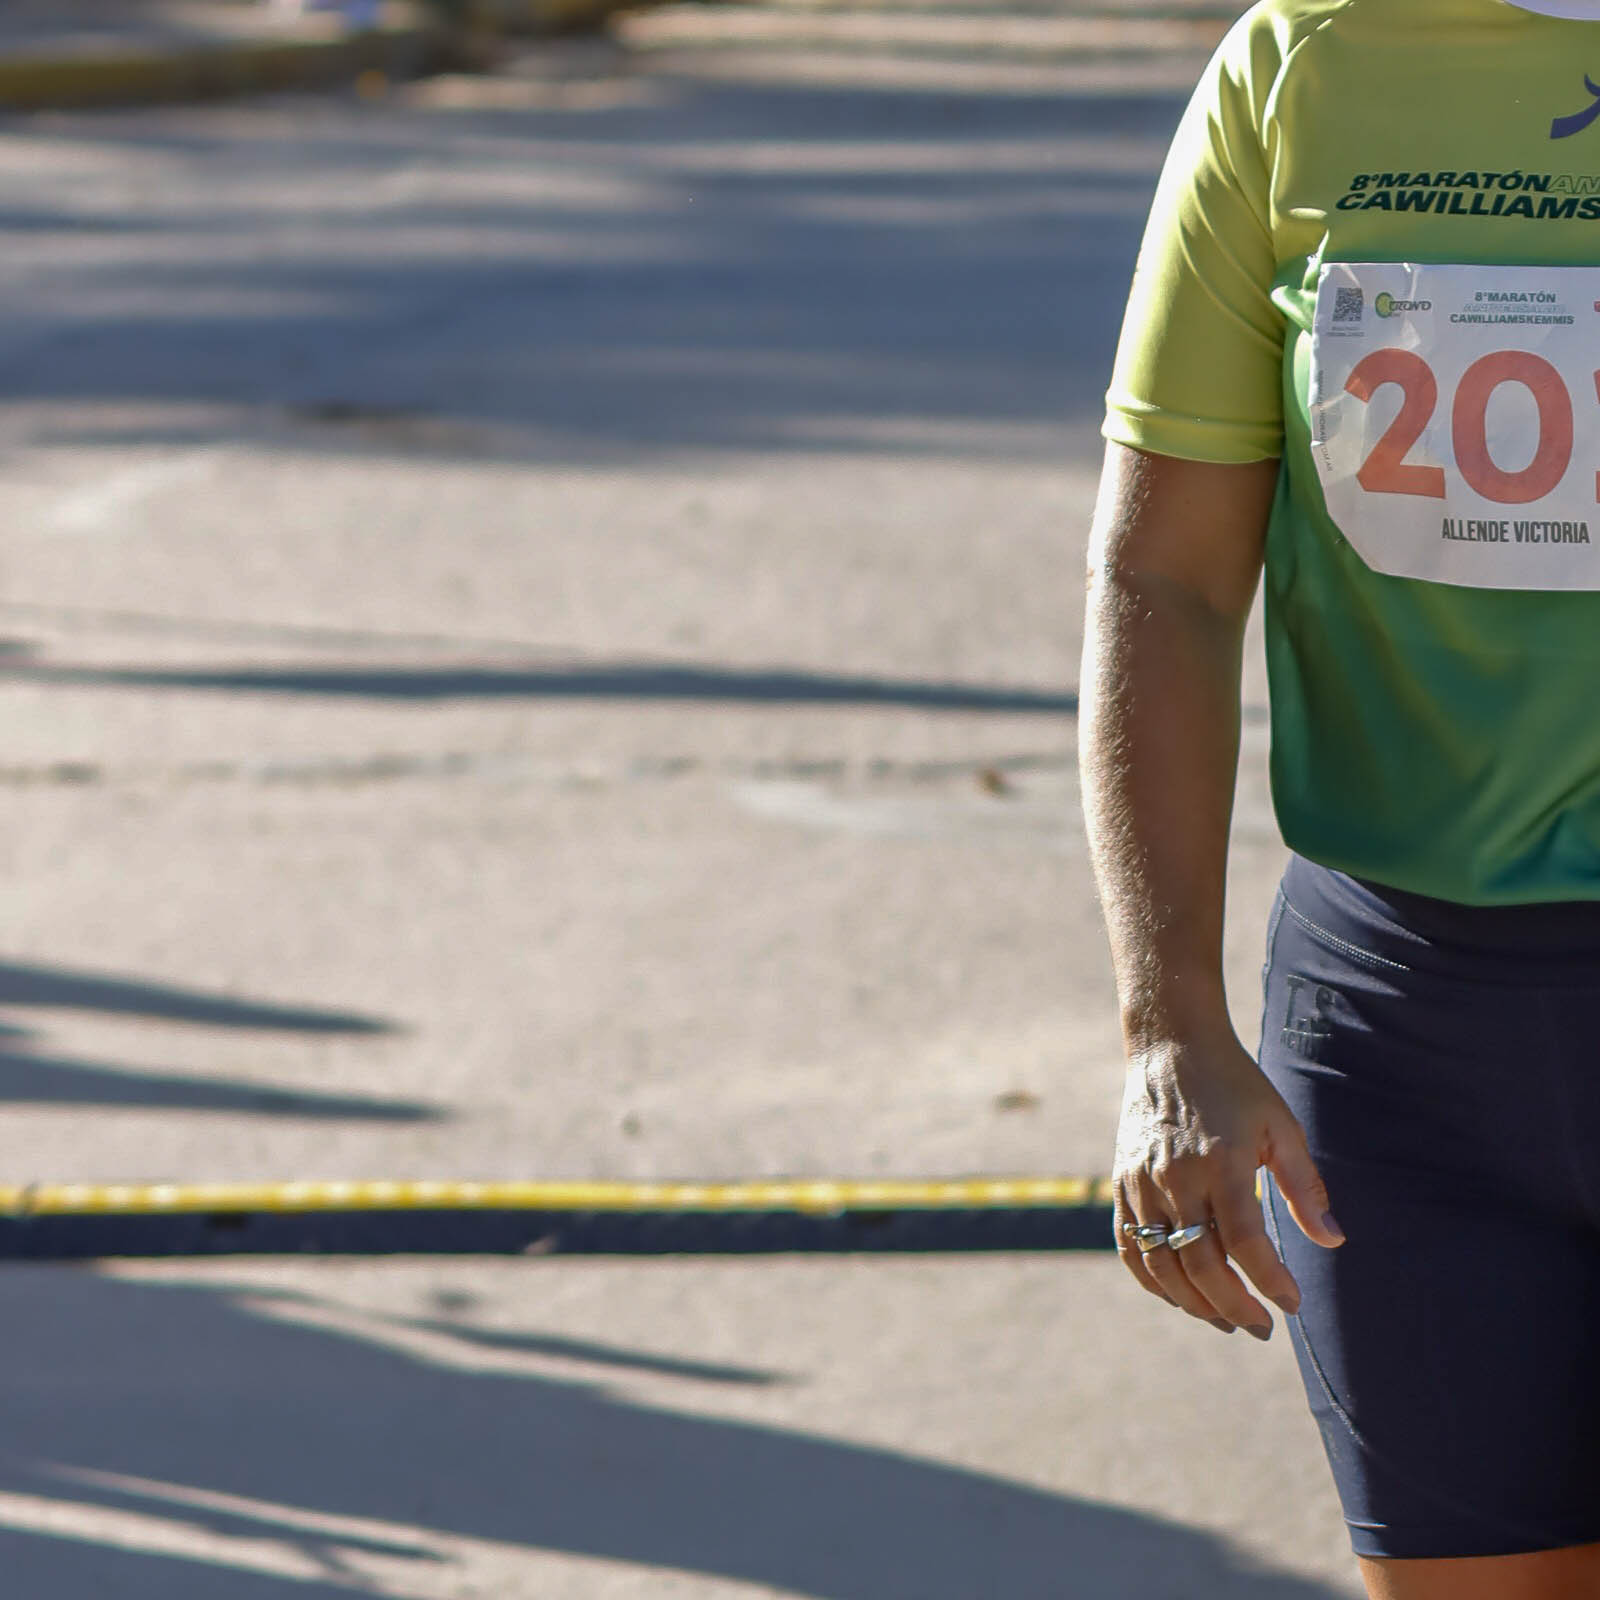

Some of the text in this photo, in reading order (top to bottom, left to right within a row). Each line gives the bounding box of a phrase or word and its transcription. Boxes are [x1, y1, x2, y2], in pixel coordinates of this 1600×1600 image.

[1449, 313, 1576, 325] CAWILLIAMSKEMMIS
[1441, 517, 1591, 544] ALLENDE VICTORIA
